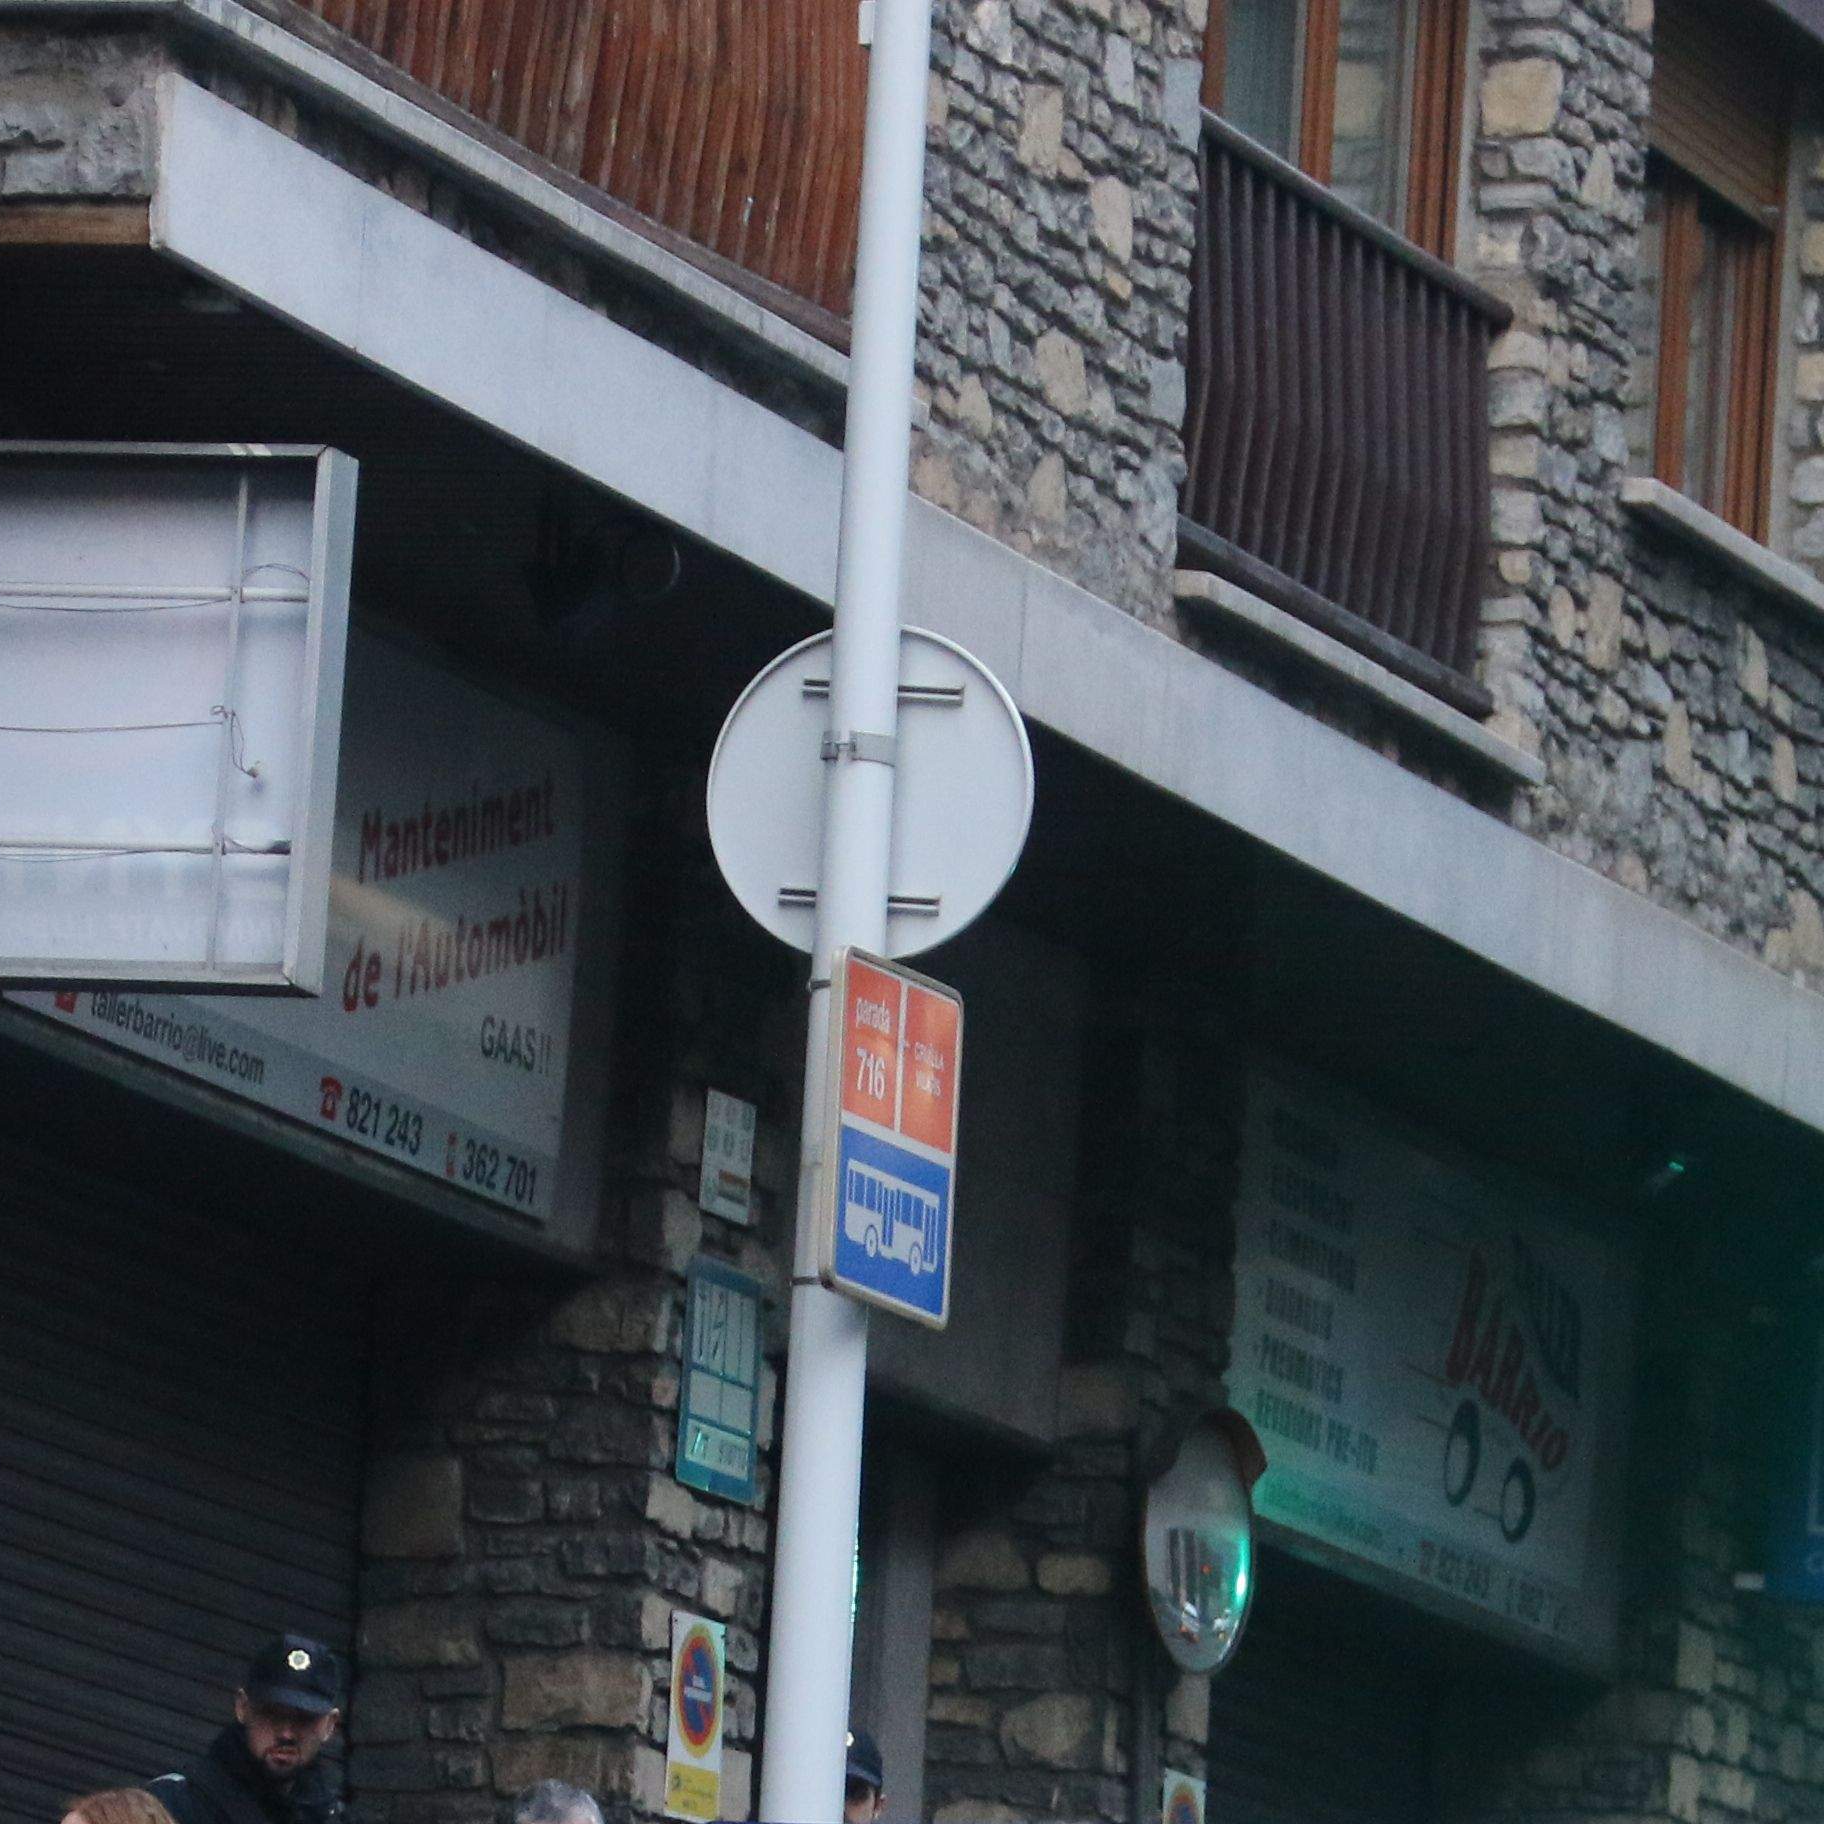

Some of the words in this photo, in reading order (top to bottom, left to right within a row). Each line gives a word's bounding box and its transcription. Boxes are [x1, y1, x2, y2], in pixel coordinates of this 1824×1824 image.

[358, 778, 556, 884] Manteniment
[343, 935, 382, 1012] de
[856, 998, 890, 1034] parada
[856, 1046, 885, 1100] 716
[346, 1087, 381, 1138] 821
[384, 1104, 423, 1156] 243
[462, 1139, 500, 1190] 362
[504, 1154, 537, 1204] 701
